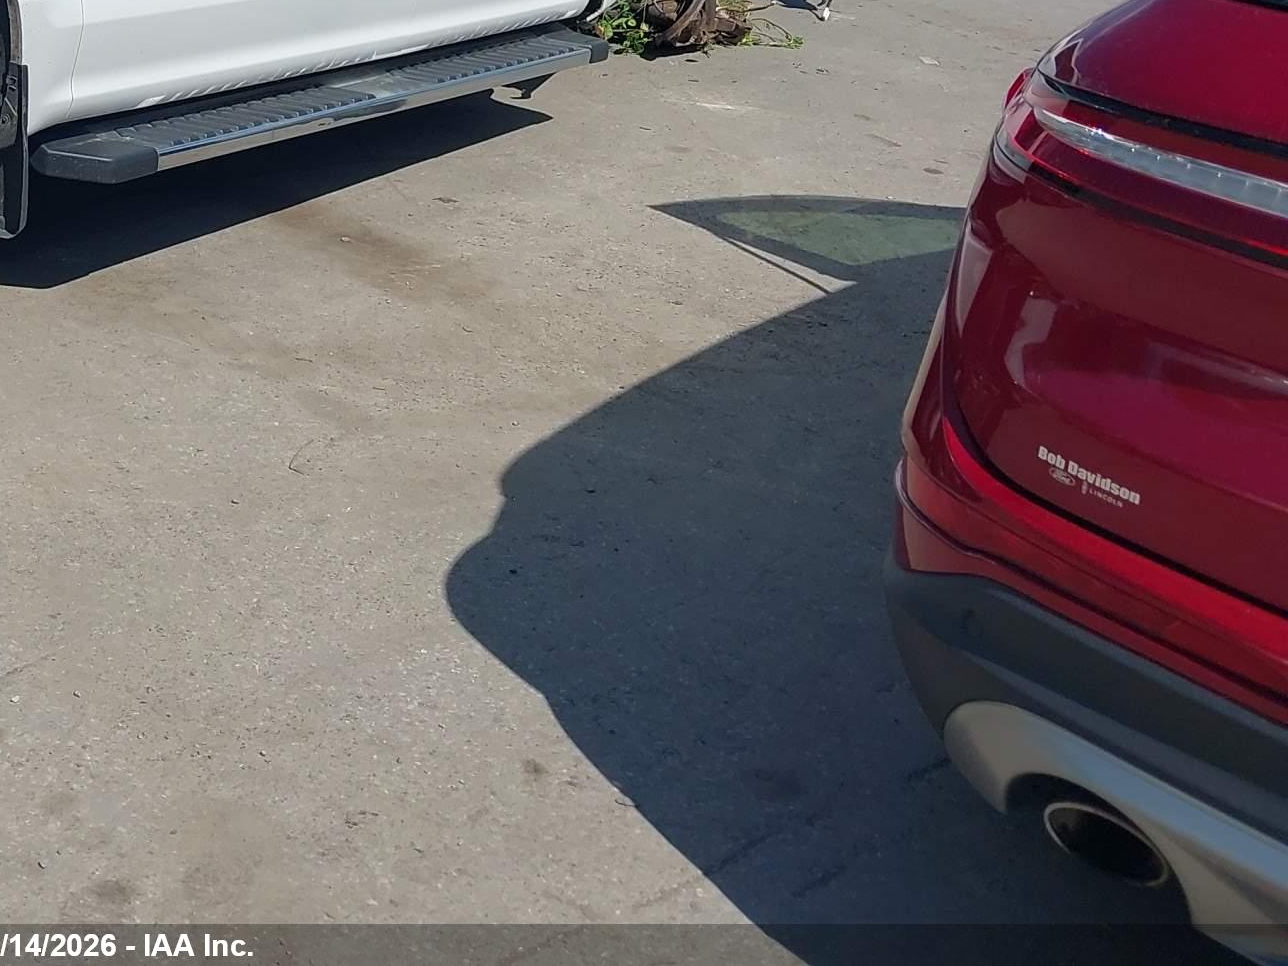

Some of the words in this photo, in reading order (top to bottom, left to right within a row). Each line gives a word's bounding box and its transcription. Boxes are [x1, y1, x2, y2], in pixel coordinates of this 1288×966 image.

[1037, 445, 1066, 470] Bob
[1067, 459, 1141, 506] Davidson
[1089, 487, 1124, 509] LINCOLN
